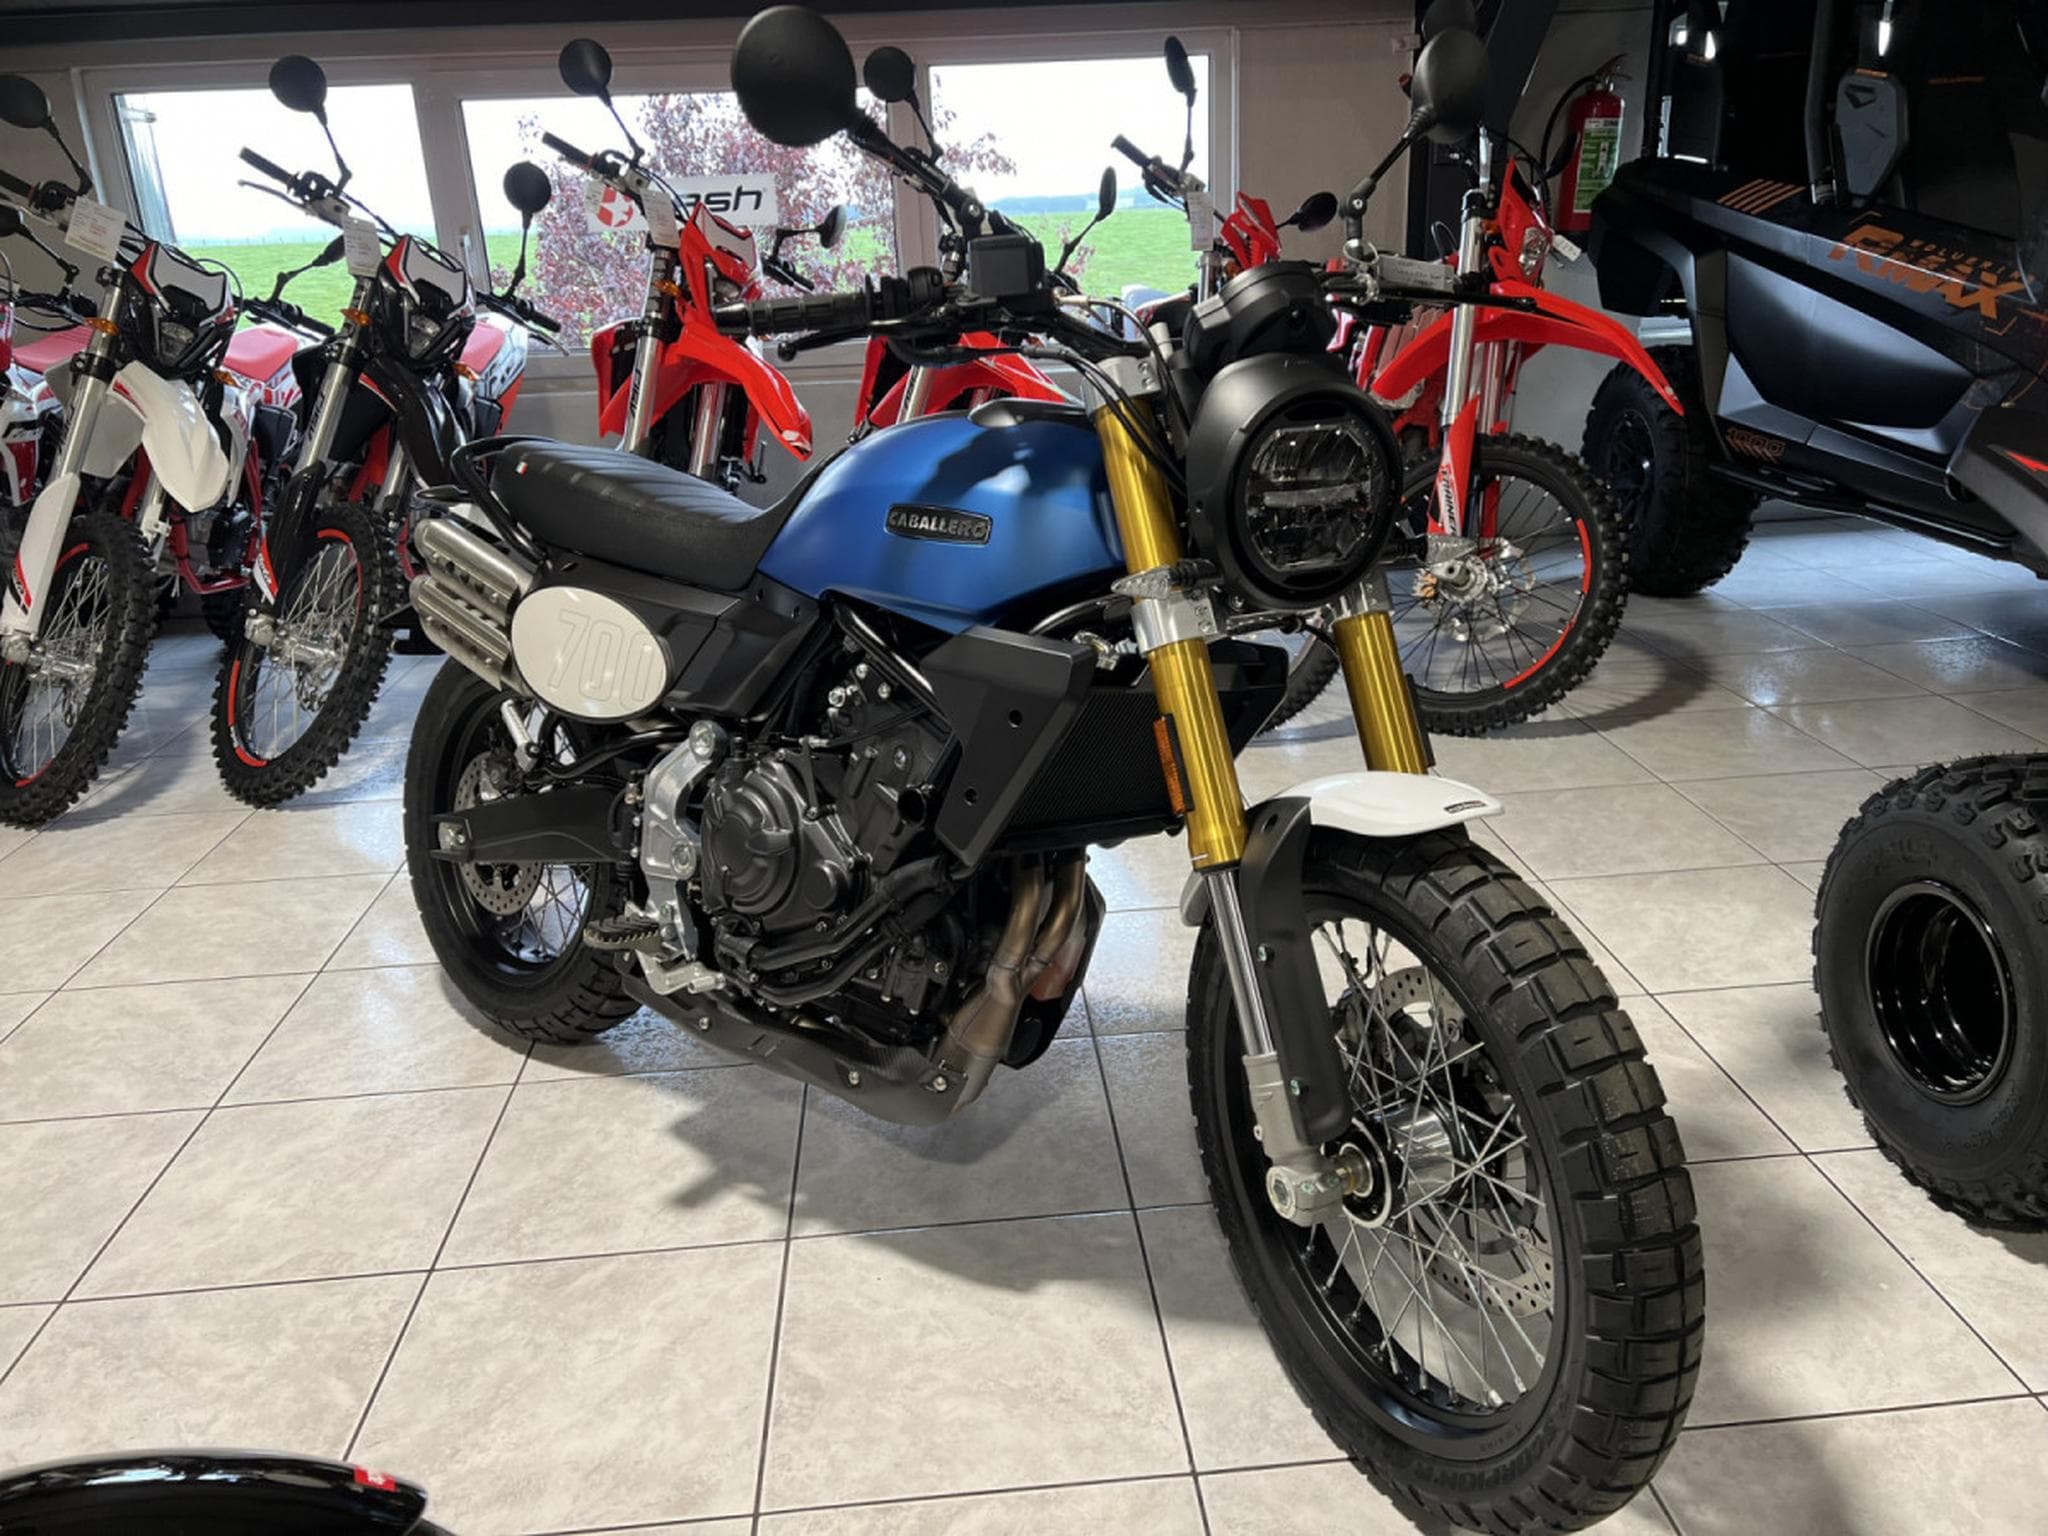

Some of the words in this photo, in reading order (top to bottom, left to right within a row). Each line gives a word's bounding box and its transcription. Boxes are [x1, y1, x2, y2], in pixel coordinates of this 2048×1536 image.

[679, 185, 763, 212] ash
[888, 511, 987, 538] CABALLERO
[548, 608, 664, 711] 700
